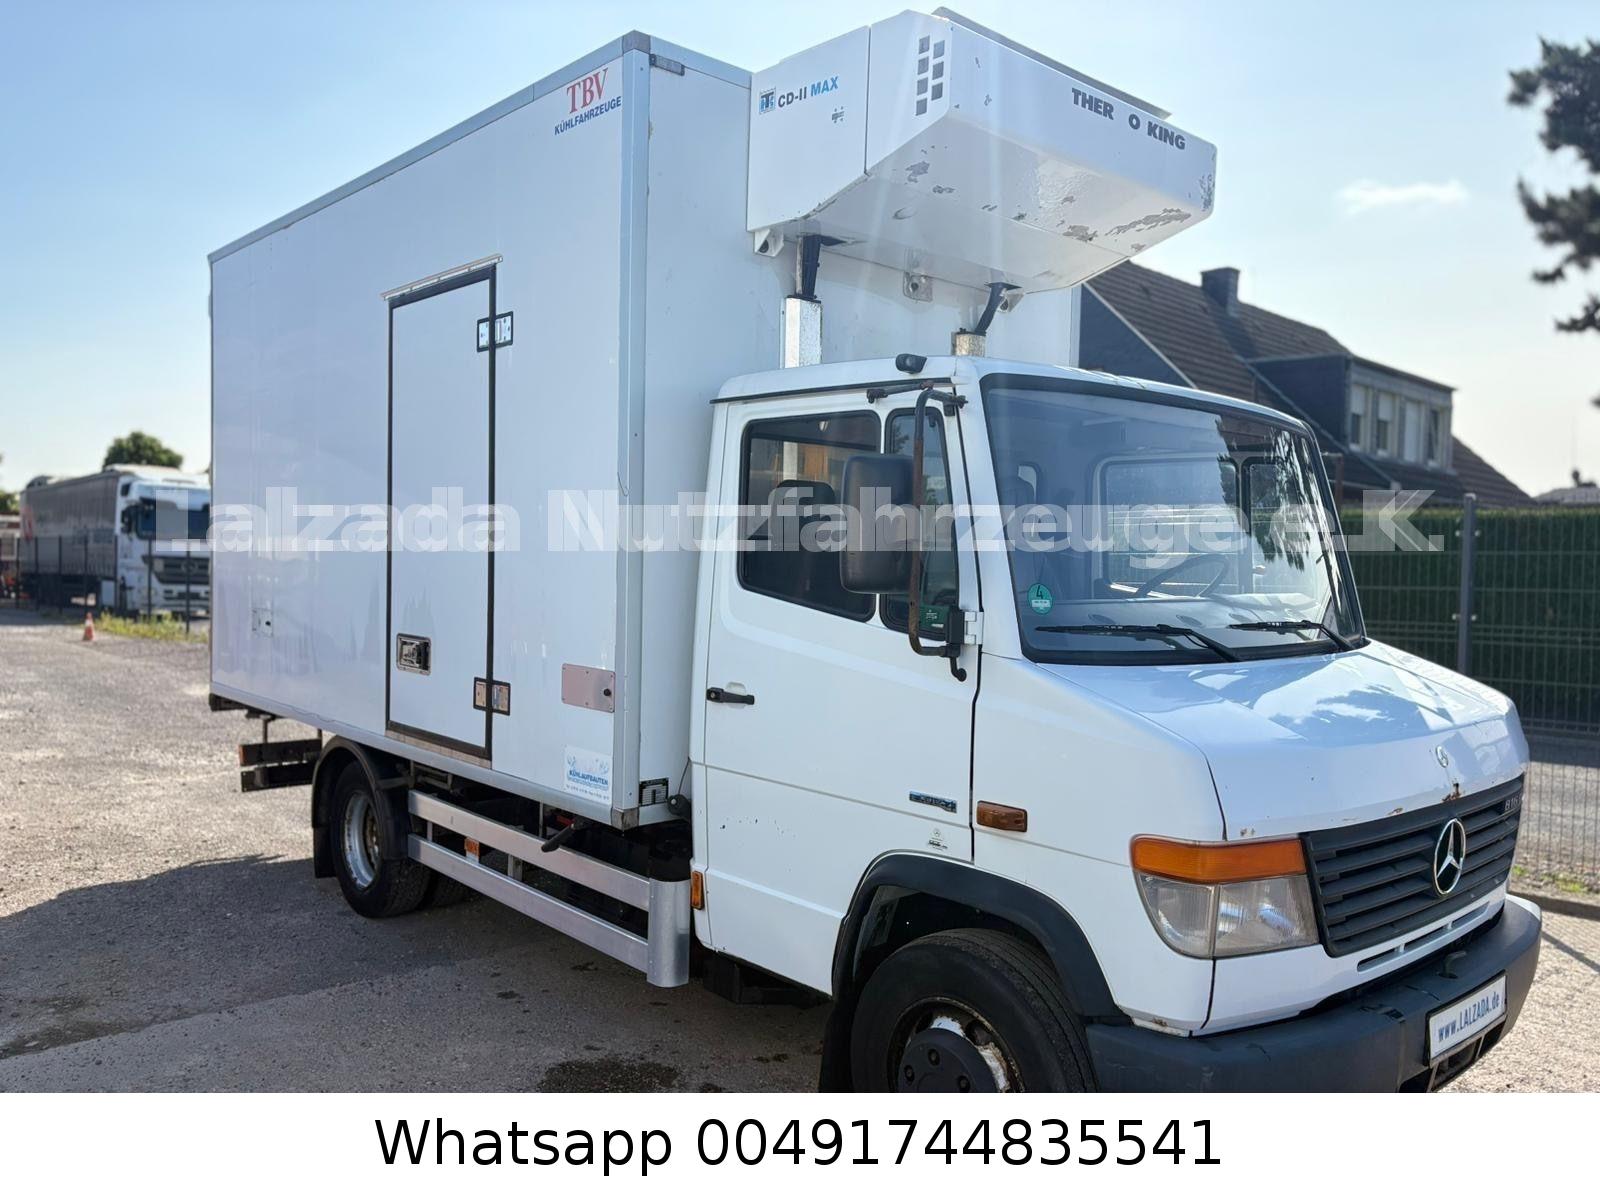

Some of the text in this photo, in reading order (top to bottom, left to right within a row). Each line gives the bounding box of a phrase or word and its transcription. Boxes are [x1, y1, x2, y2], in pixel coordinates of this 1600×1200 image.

[566, 68, 609, 115] TBV
[777, 86, 808, 109] CD-II
[810, 75, 840, 98] MAX
[554, 96, 622, 137] KÜHLFAHRZEUGE
[1147, 121, 1186, 150] KING
[1036, 585, 1044, 600] 4
[1438, 991, 1500, 1042] www.LALZADA.de
